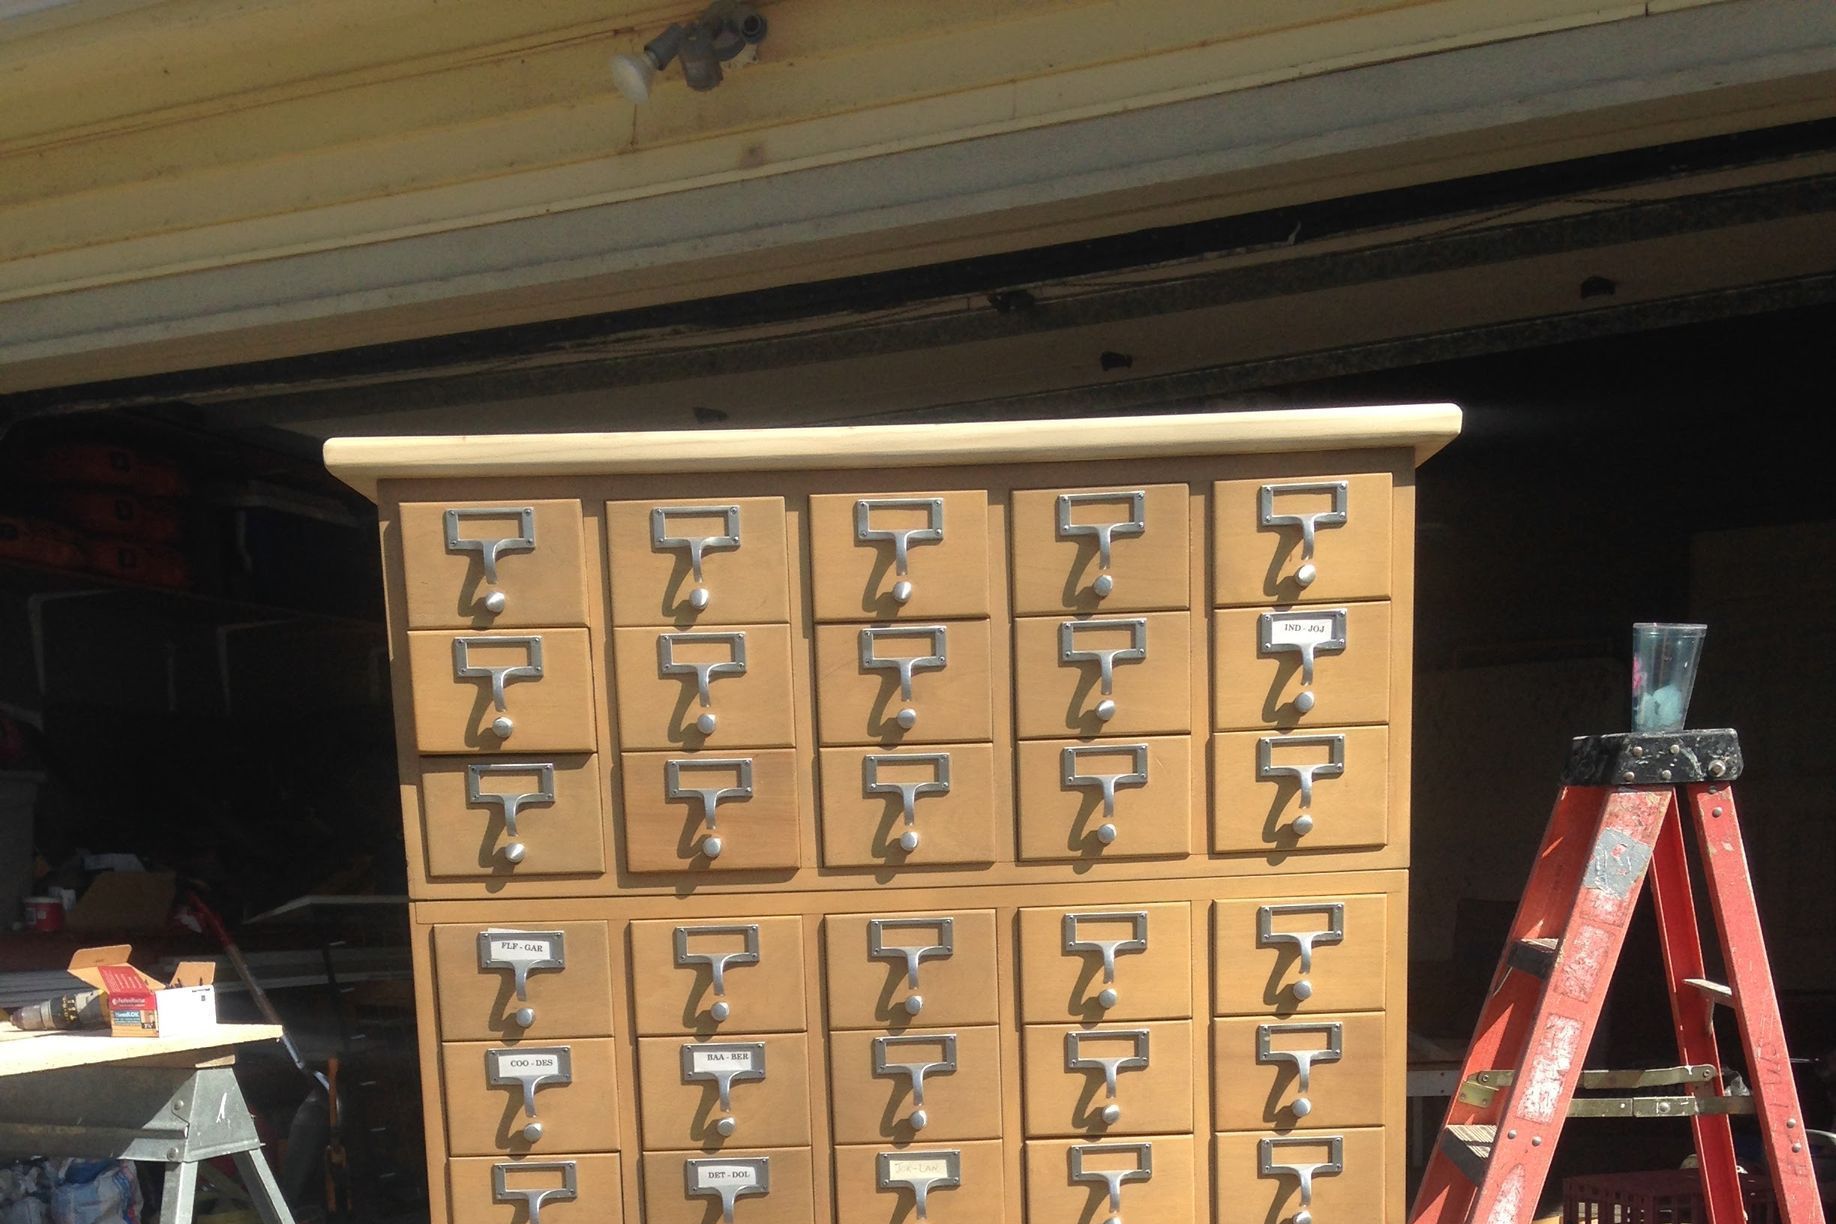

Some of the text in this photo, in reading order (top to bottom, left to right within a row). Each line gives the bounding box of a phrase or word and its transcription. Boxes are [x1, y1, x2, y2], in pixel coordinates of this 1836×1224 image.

[1308, 625, 1325, 633] JOJ
[501, 942, 518, 950] FLF
[525, 944, 543, 952] GAR
